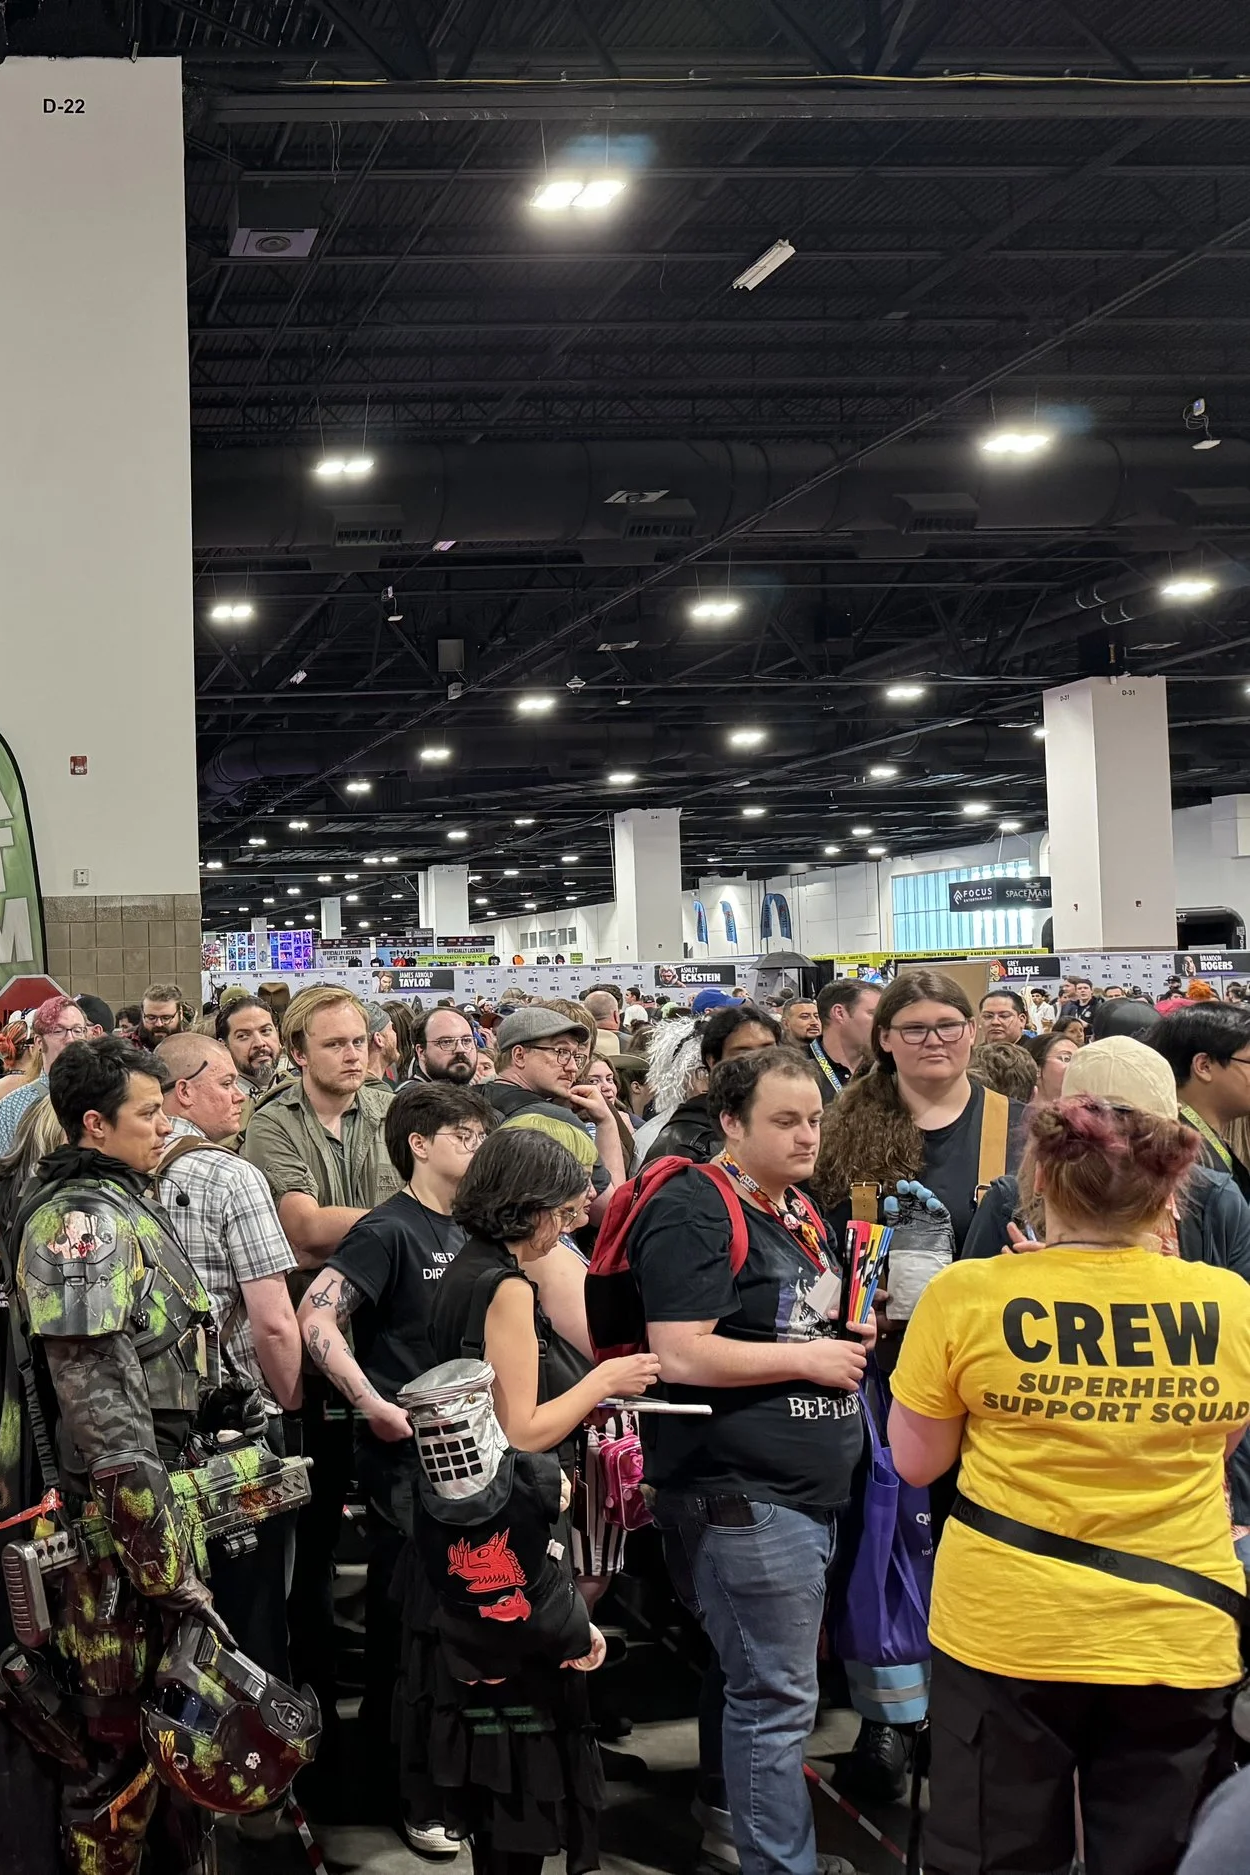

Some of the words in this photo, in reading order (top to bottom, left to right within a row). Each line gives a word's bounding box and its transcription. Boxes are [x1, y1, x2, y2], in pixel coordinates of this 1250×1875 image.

[43, 98, 86, 115] D-22
[963, 888, 993, 898] FOCUS
[1007, 966, 1039, 976] DELISLE
[1200, 961, 1233, 971] ROGERS
[399, 978, 431, 987] TAYLOR
[681, 973, 721, 983] ECKSTEIN
[423, 1267, 446, 1280] DIR
[1002, 1297, 1220, 1367] CREW
[1017, 1373, 1220, 1398] SUPERHERO
[982, 1392, 1142, 1423] SUPPORT
[1150, 1401, 1250, 1426] SQUAD
